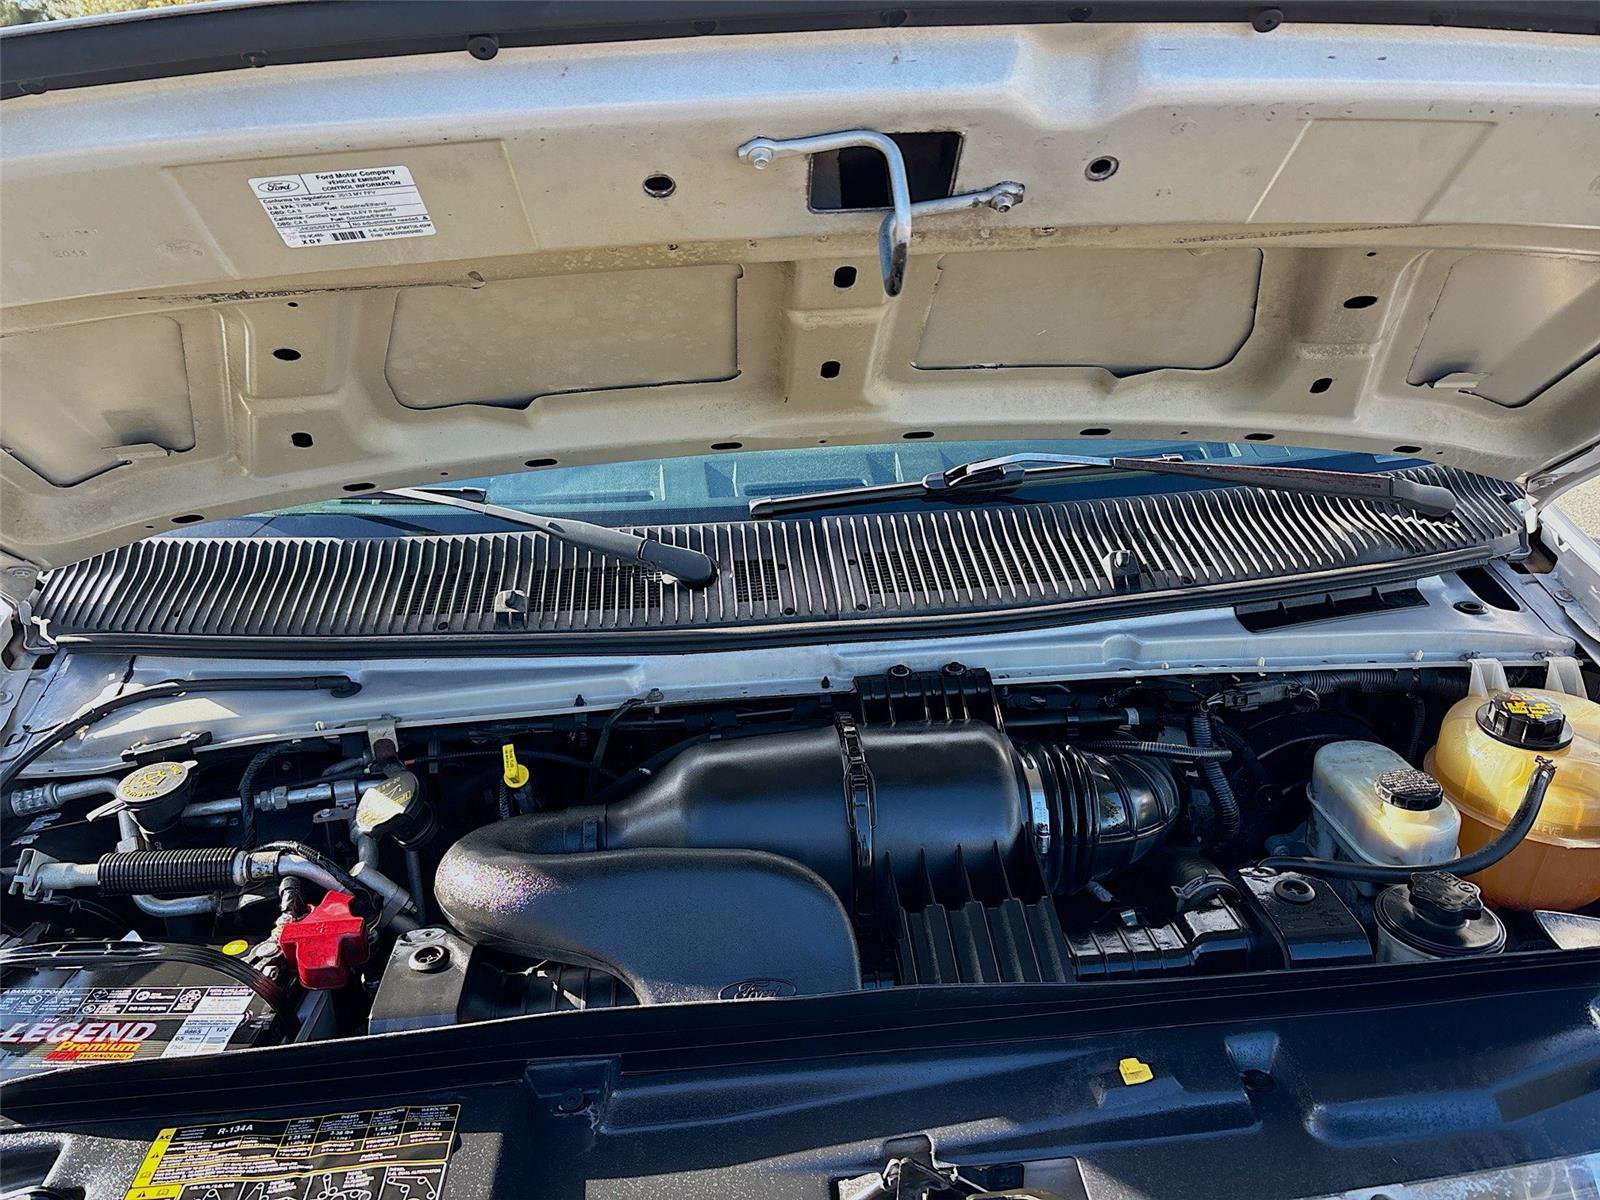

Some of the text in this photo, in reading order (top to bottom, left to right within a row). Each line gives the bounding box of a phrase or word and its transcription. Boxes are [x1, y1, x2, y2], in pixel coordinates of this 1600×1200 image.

[359, 169, 395, 178] Company
[267, 183, 290, 191] Ford
[0, 1022, 157, 1043] LEGEND
[54, 1041, 141, 1051] Premium
[217, 1124, 253, 1135] R-134A
